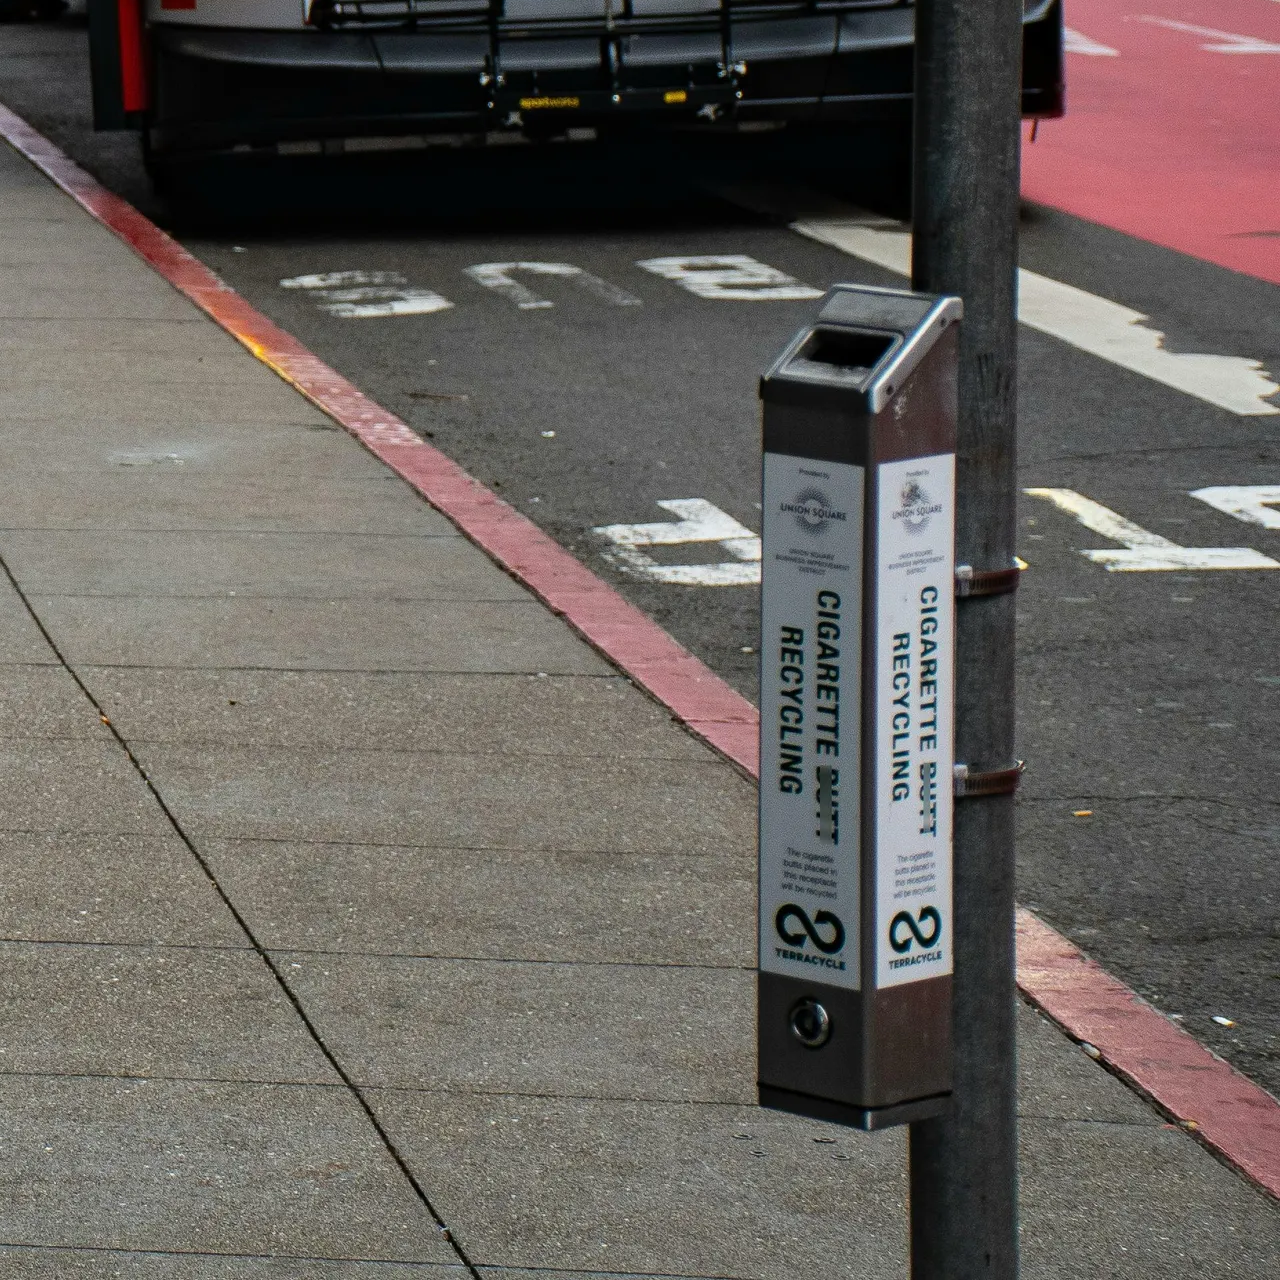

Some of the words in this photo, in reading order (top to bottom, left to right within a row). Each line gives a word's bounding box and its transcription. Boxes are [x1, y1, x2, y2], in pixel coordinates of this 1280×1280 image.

[780, 502, 810, 516] UNION
[811, 507, 847, 521] SQUARE
[892, 509, 915, 520] UNION
[916, 504, 942, 517] SQUARE
[780, 625, 804, 795] RECYCLING
[816, 590, 840, 757] CIGARETTE
[920, 585, 938, 752] CIGARETTE
[892, 632, 911, 802] RECYCLING
[775, 947, 846, 971] TERRACYCLE
[888, 951, 942, 970] TERRACYCLE
